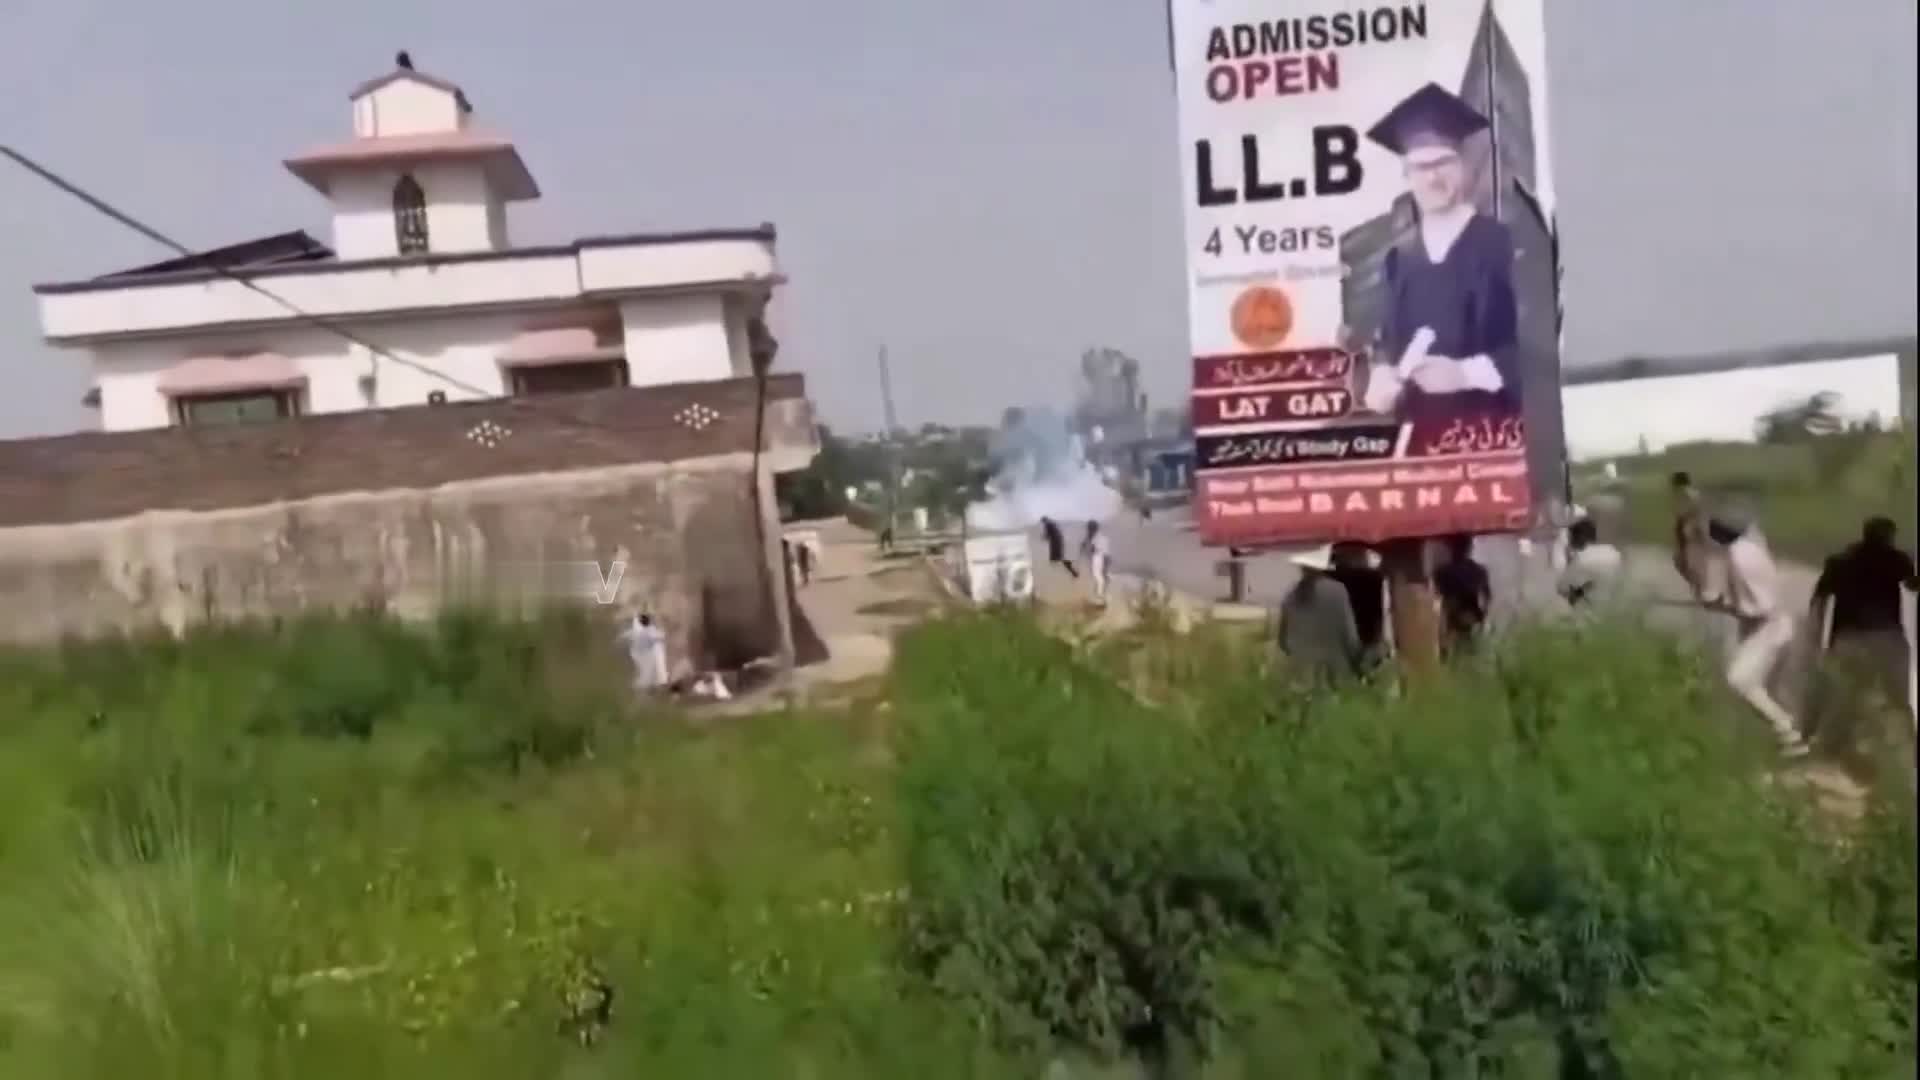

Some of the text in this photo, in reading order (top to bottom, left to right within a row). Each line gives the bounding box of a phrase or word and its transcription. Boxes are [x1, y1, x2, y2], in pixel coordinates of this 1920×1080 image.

[1206, 5, 1428, 61] ADMISSION
[1205, 53, 1341, 102] OPEN
[1195, 125, 1363, 206] LL.B
[1203, 223, 1336, 257] 4 Years
[1218, 390, 1346, 419] LAT GAT
